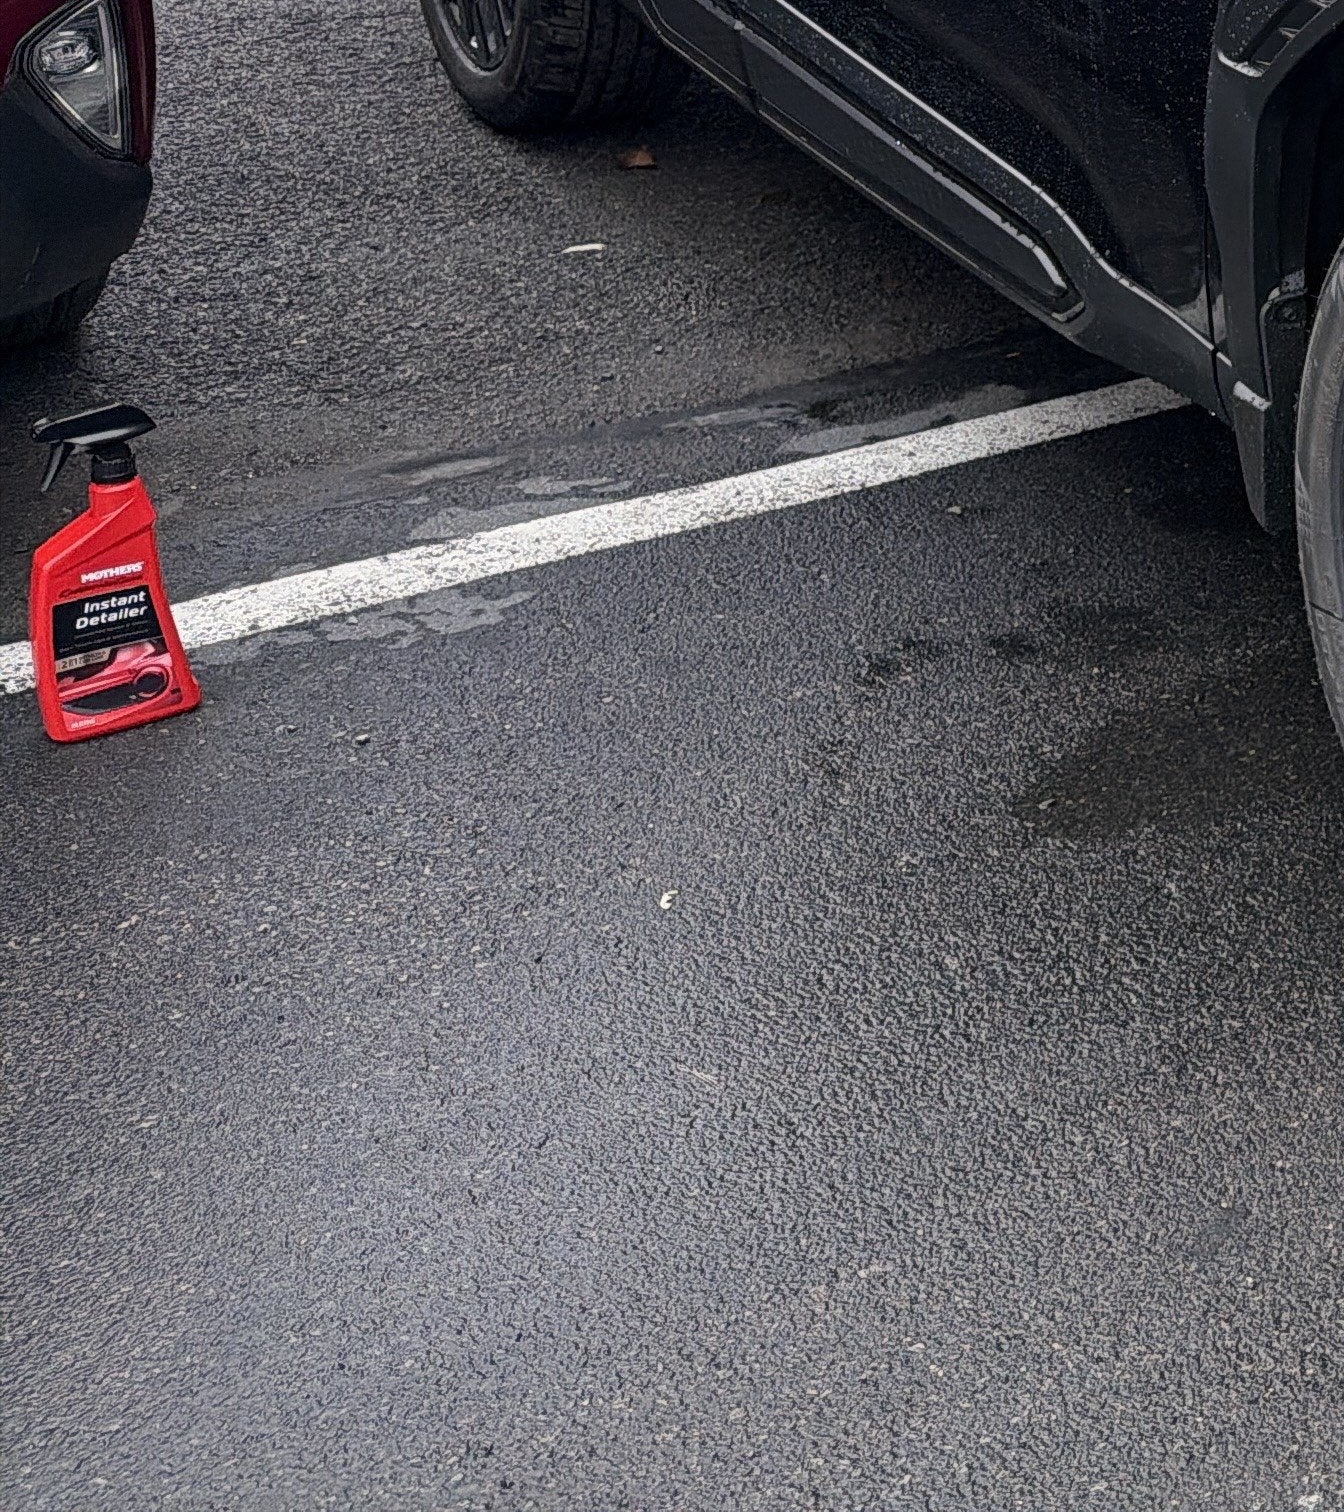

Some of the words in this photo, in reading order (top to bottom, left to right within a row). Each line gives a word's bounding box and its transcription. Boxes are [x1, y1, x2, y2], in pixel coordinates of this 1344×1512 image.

[80, 560, 145, 584] MOTHERS
[84, 590, 147, 614] Instant
[75, 605, 148, 629] Detailer
